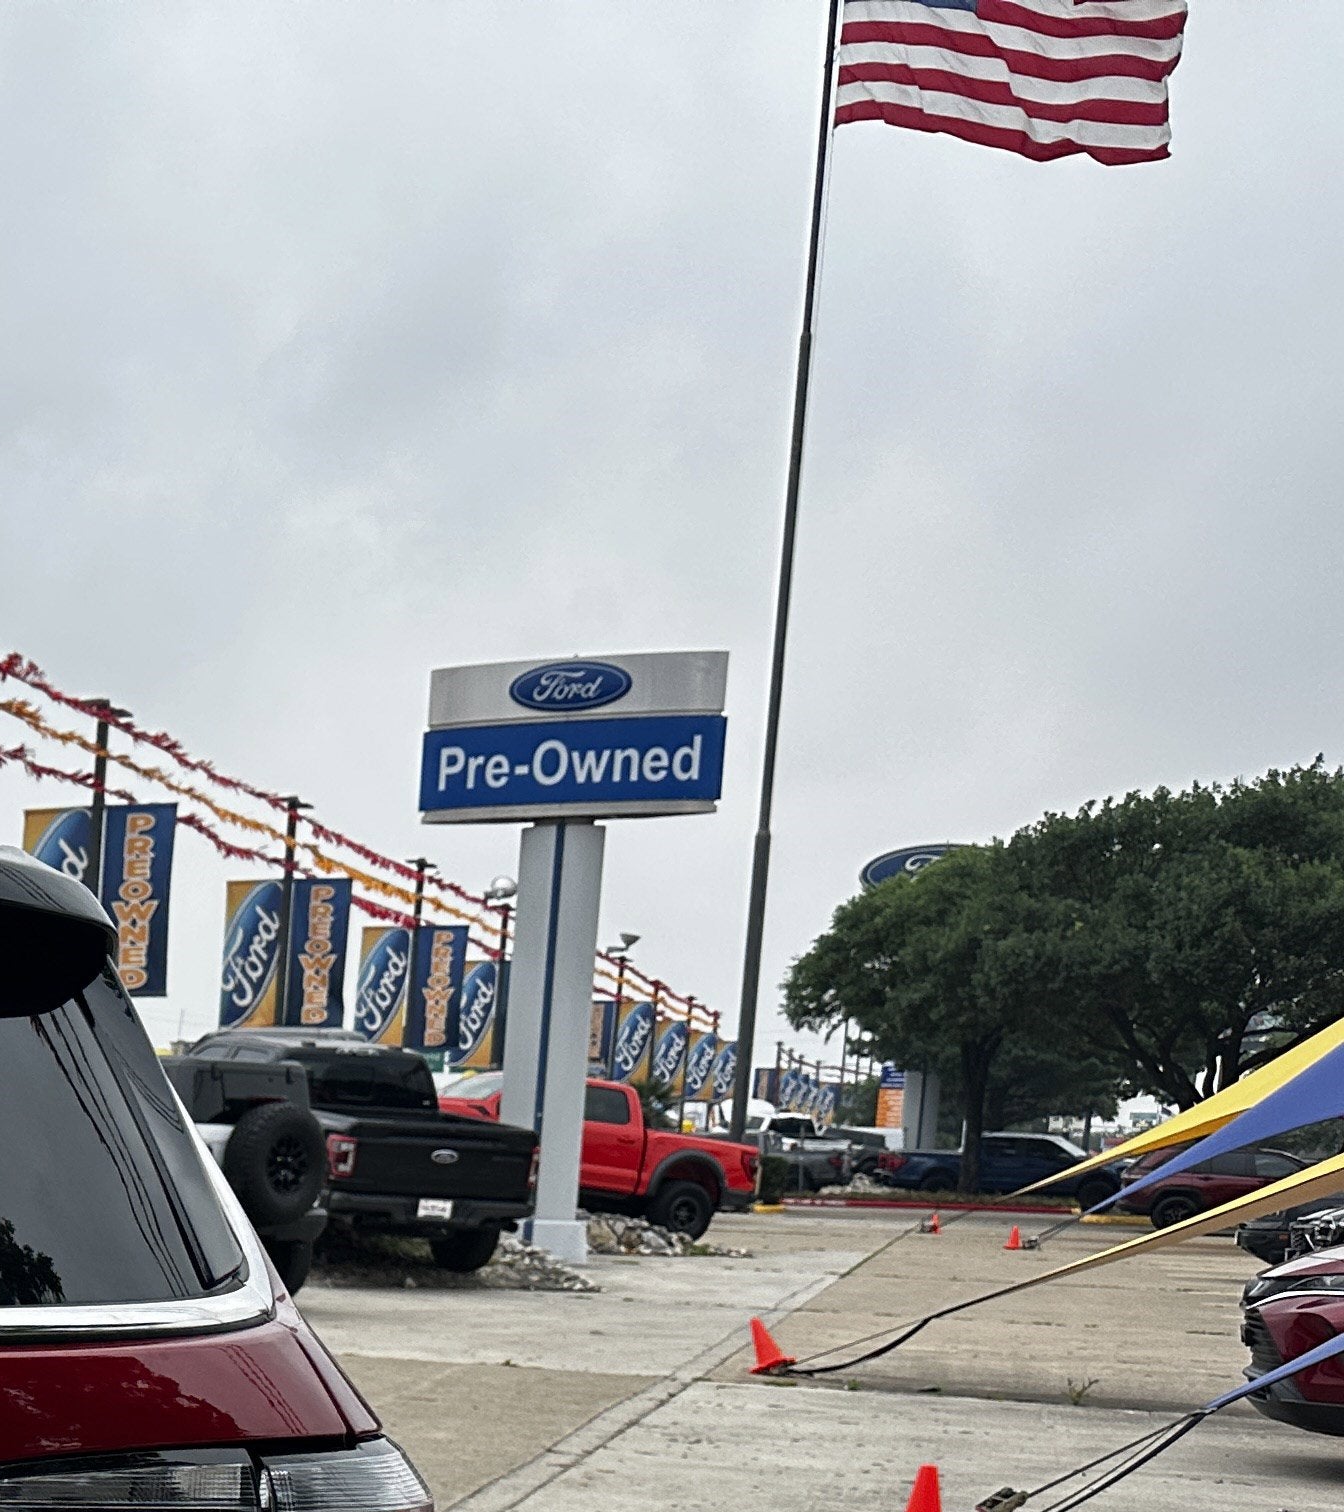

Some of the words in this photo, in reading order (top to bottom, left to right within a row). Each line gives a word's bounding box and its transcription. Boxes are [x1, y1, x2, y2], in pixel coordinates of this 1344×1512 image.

[532, 670, 604, 702] Ford
[437, 733, 703, 792] Pre-Owned
[110, 811, 161, 990] PREOWNED
[221, 904, 280, 1008] Ford
[297, 884, 339, 1025] PREOWNED
[355, 946, 407, 1032] Ford
